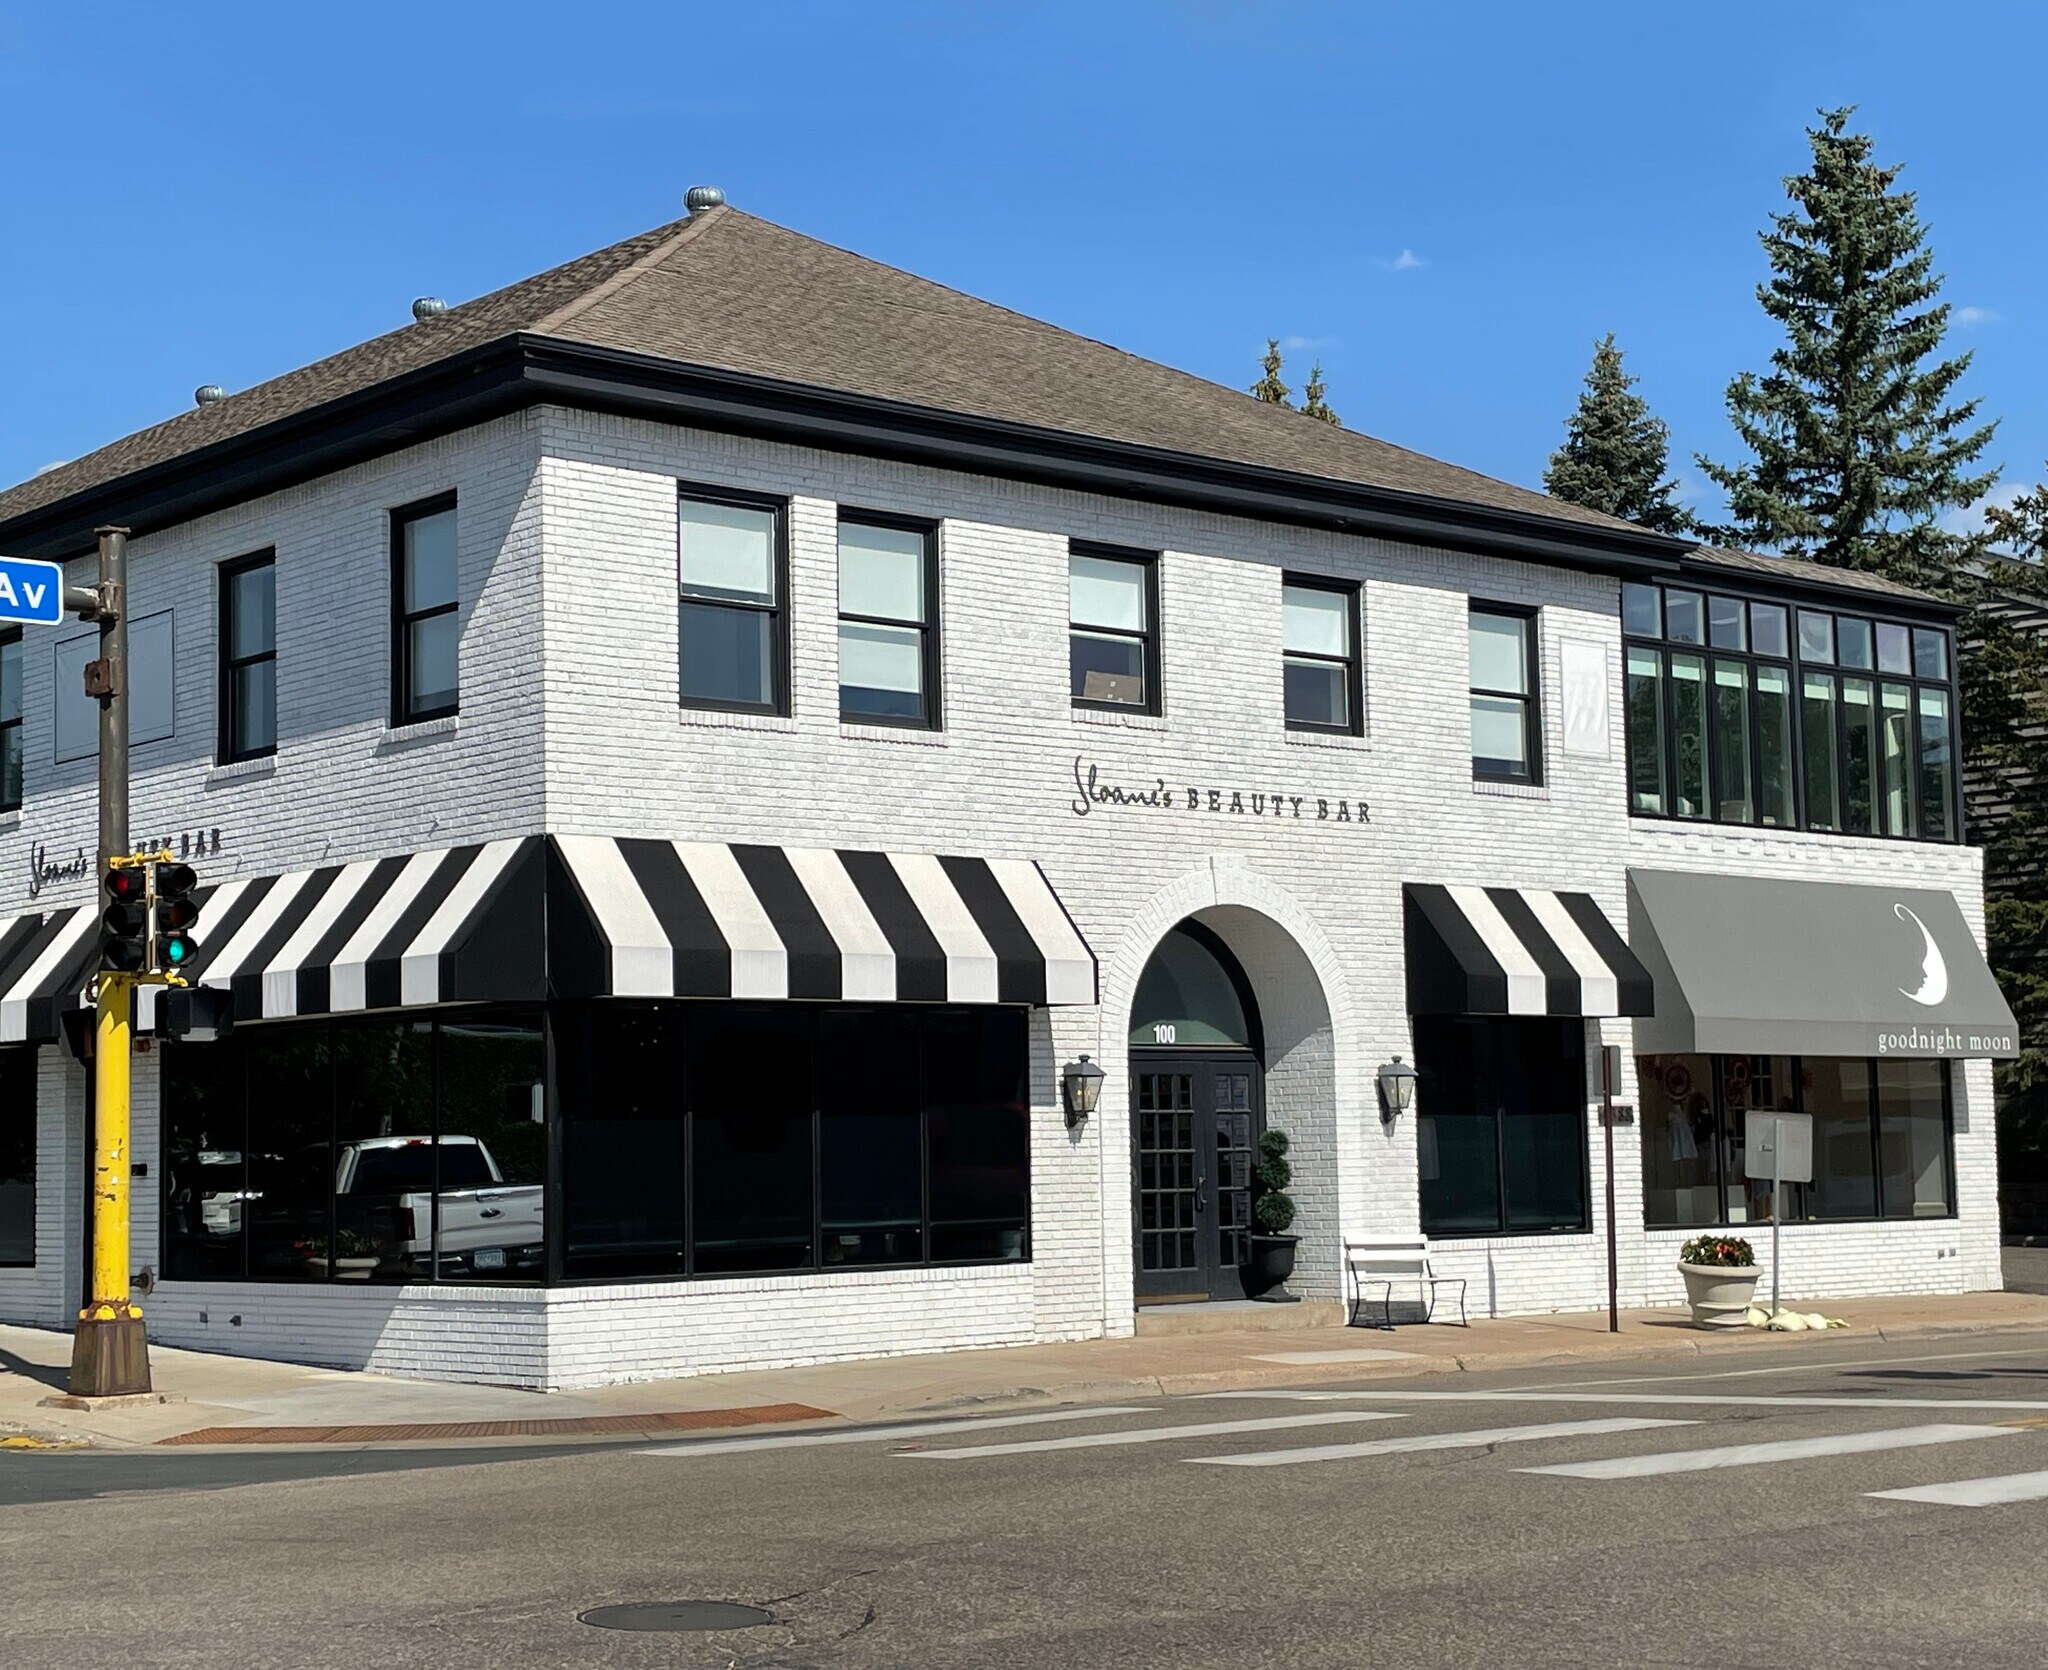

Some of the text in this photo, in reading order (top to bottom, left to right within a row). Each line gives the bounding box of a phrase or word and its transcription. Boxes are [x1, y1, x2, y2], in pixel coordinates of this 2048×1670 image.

[0, 572, 46, 609] Av
[1072, 755, 1371, 823] Sloane's BEAUTY BAR
[1153, 1024, 1176, 1044] 100
[1878, 1026, 2012, 1054] goodnight moon
